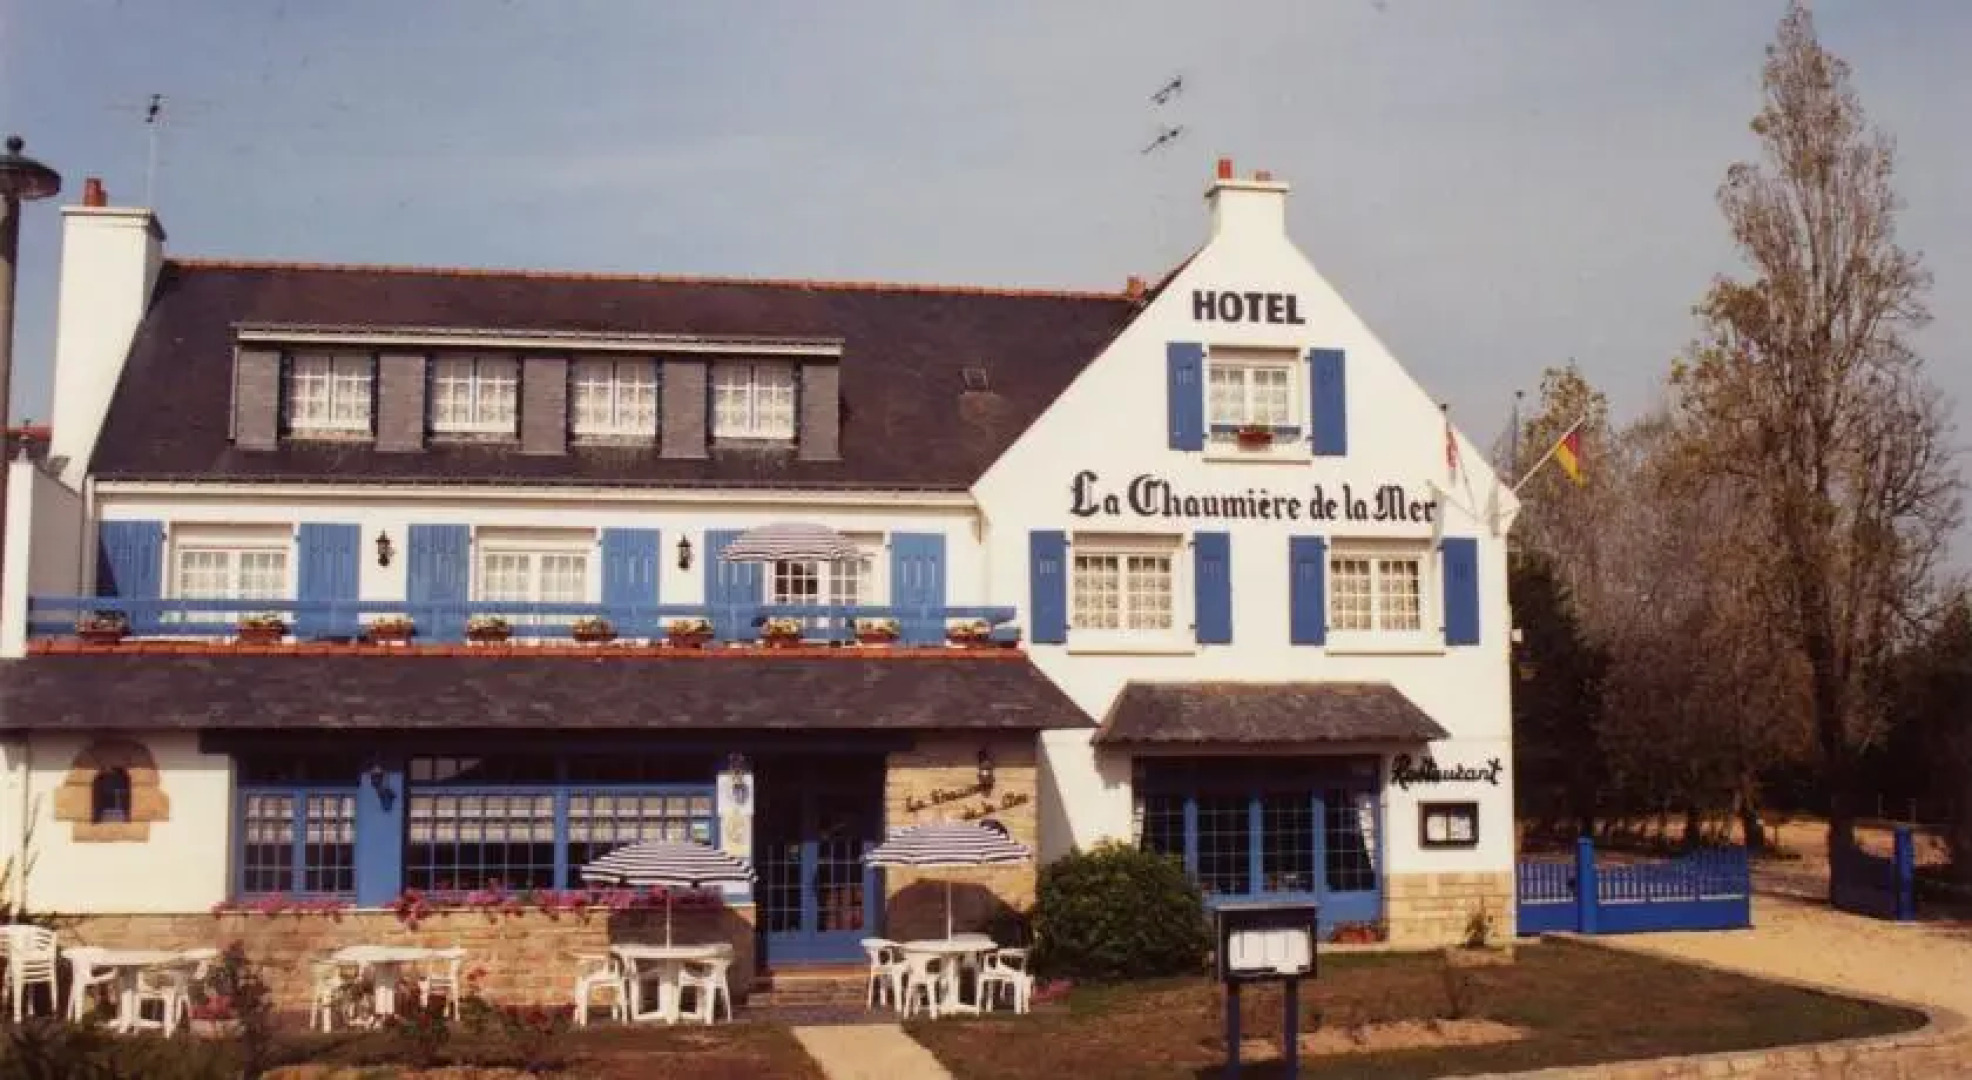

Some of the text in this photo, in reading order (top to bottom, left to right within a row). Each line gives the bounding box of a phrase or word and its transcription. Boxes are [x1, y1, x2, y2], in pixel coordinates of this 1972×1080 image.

[1192, 290, 1305, 325] HOTEL
[1070, 470, 1437, 522] La Chaumière de la Mer
